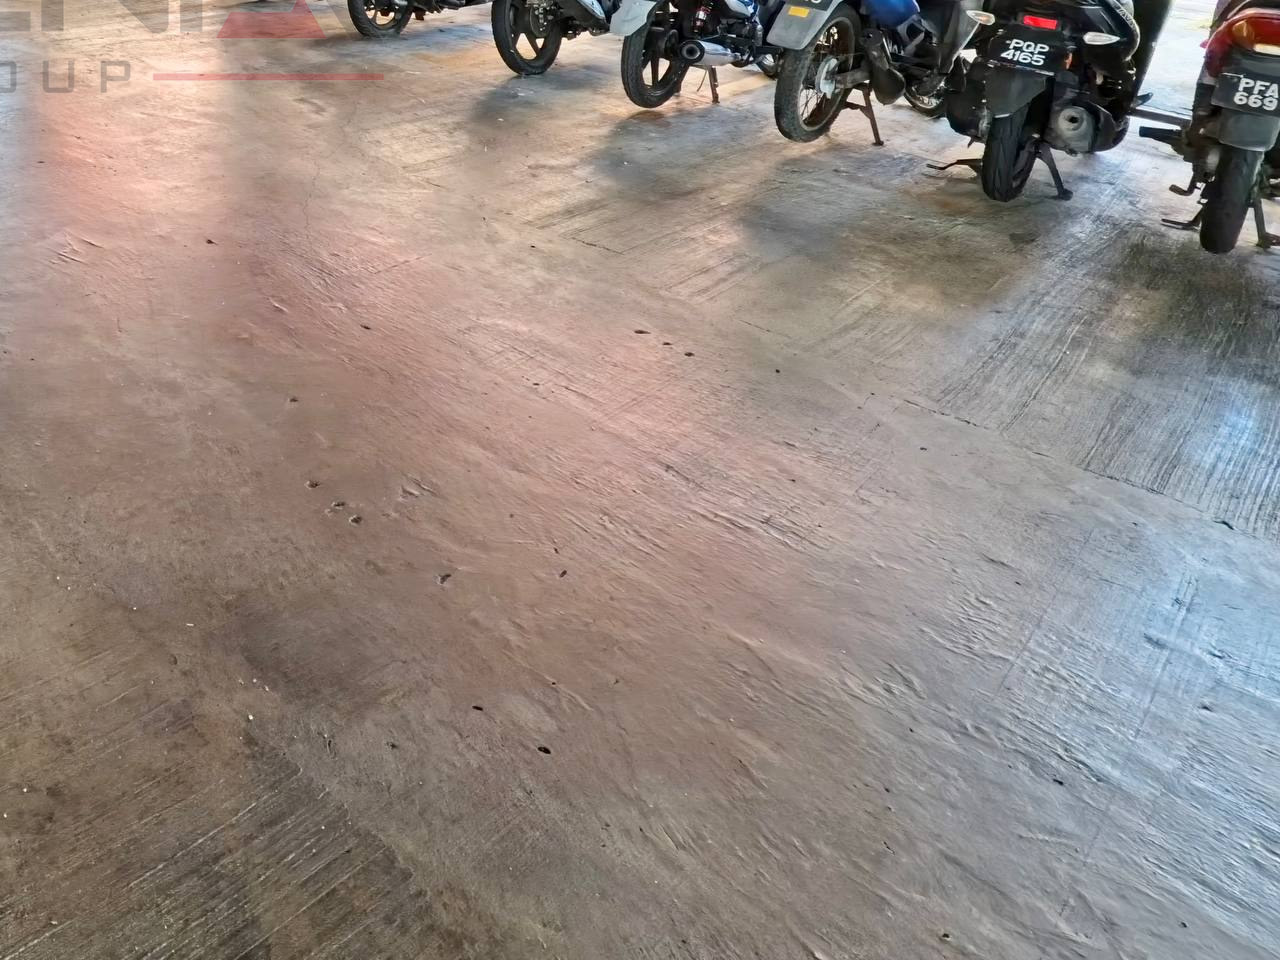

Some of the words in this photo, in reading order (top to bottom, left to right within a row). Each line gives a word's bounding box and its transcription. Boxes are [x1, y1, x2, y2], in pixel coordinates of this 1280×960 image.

[1008, 38, 1050, 54] PQP
[1000, 49, 1046, 66] 4165
[1238, 78, 1279, 98] PFA
[1234, 92, 1278, 111] 669
